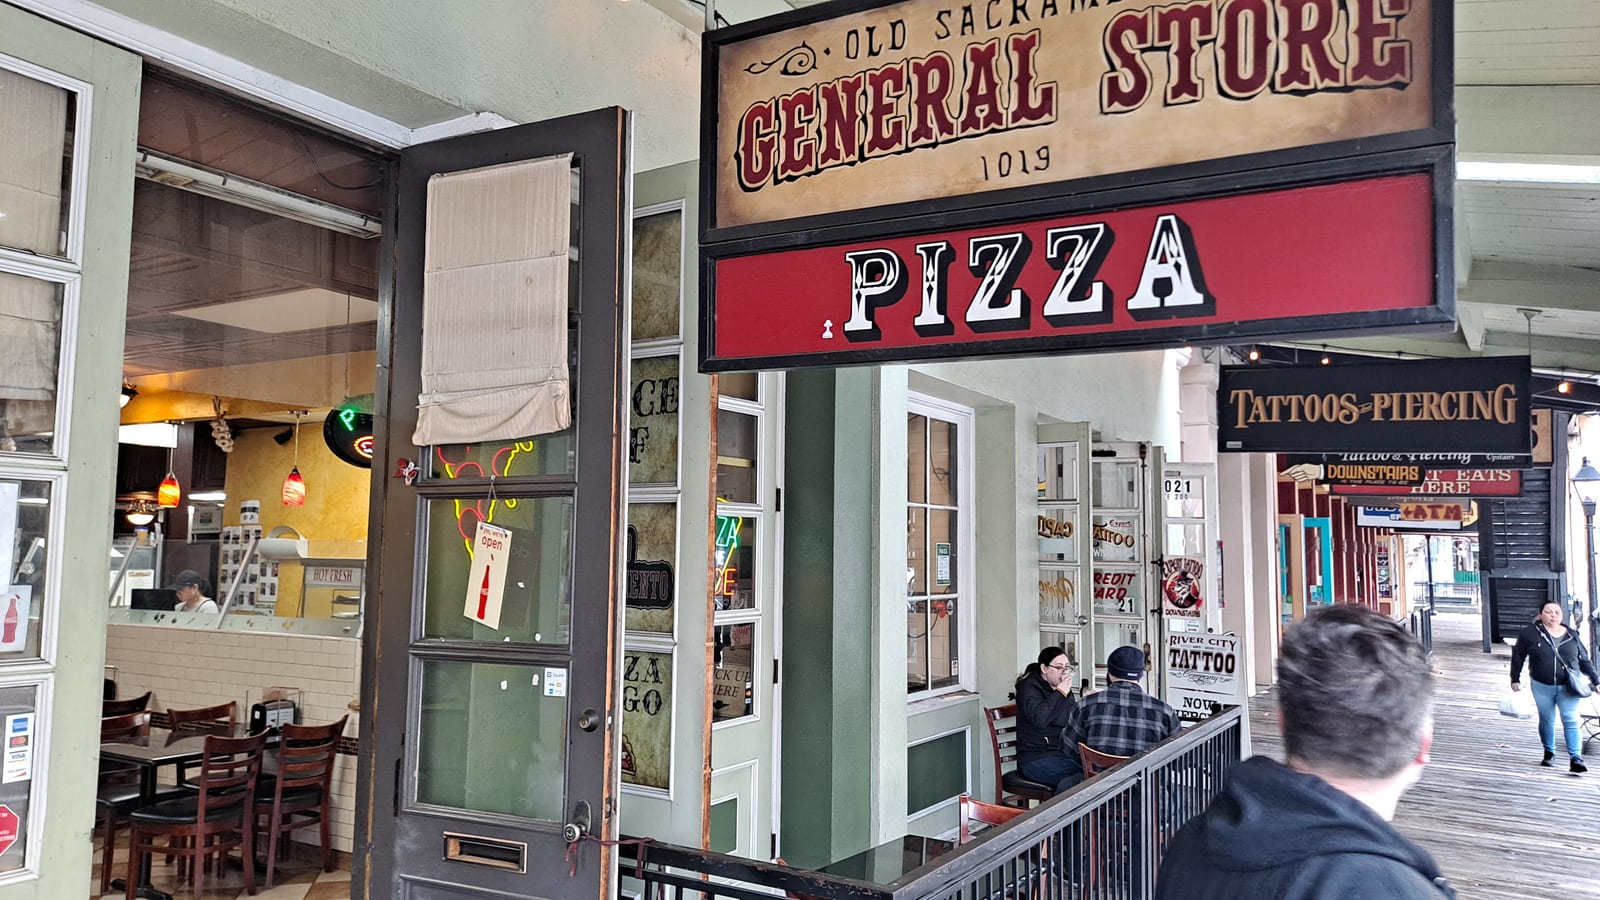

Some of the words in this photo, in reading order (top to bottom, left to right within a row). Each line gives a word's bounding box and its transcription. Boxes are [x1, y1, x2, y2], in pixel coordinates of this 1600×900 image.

[845, 19, 906, 60] OLD
[734, 28, 1058, 193] GENERAL
[1100, 0, 1412, 114] STORE
[981, 146, 1051, 181] 1019
[844, 214, 1216, 343] PIZZA
[1229, 389, 1358, 428] TATTOOS
[1370, 384, 1518, 424] PIERCING
[1328, 464, 1418, 481] DOWNSTAIRS
[1456, 469, 1512, 481] EATS
[1413, 504, 1462, 520] ATM
[481, 536, 503, 551] open
[627, 569, 669, 601] ENTO
[1165, 608, 1201, 617] DOWNSTAIRS
[1170, 635, 1204, 646] RIVER
[1208, 638, 1237, 652] CITY
[1169, 648, 1236, 674] TATTOO
[1182, 697, 1217, 711] NOW
